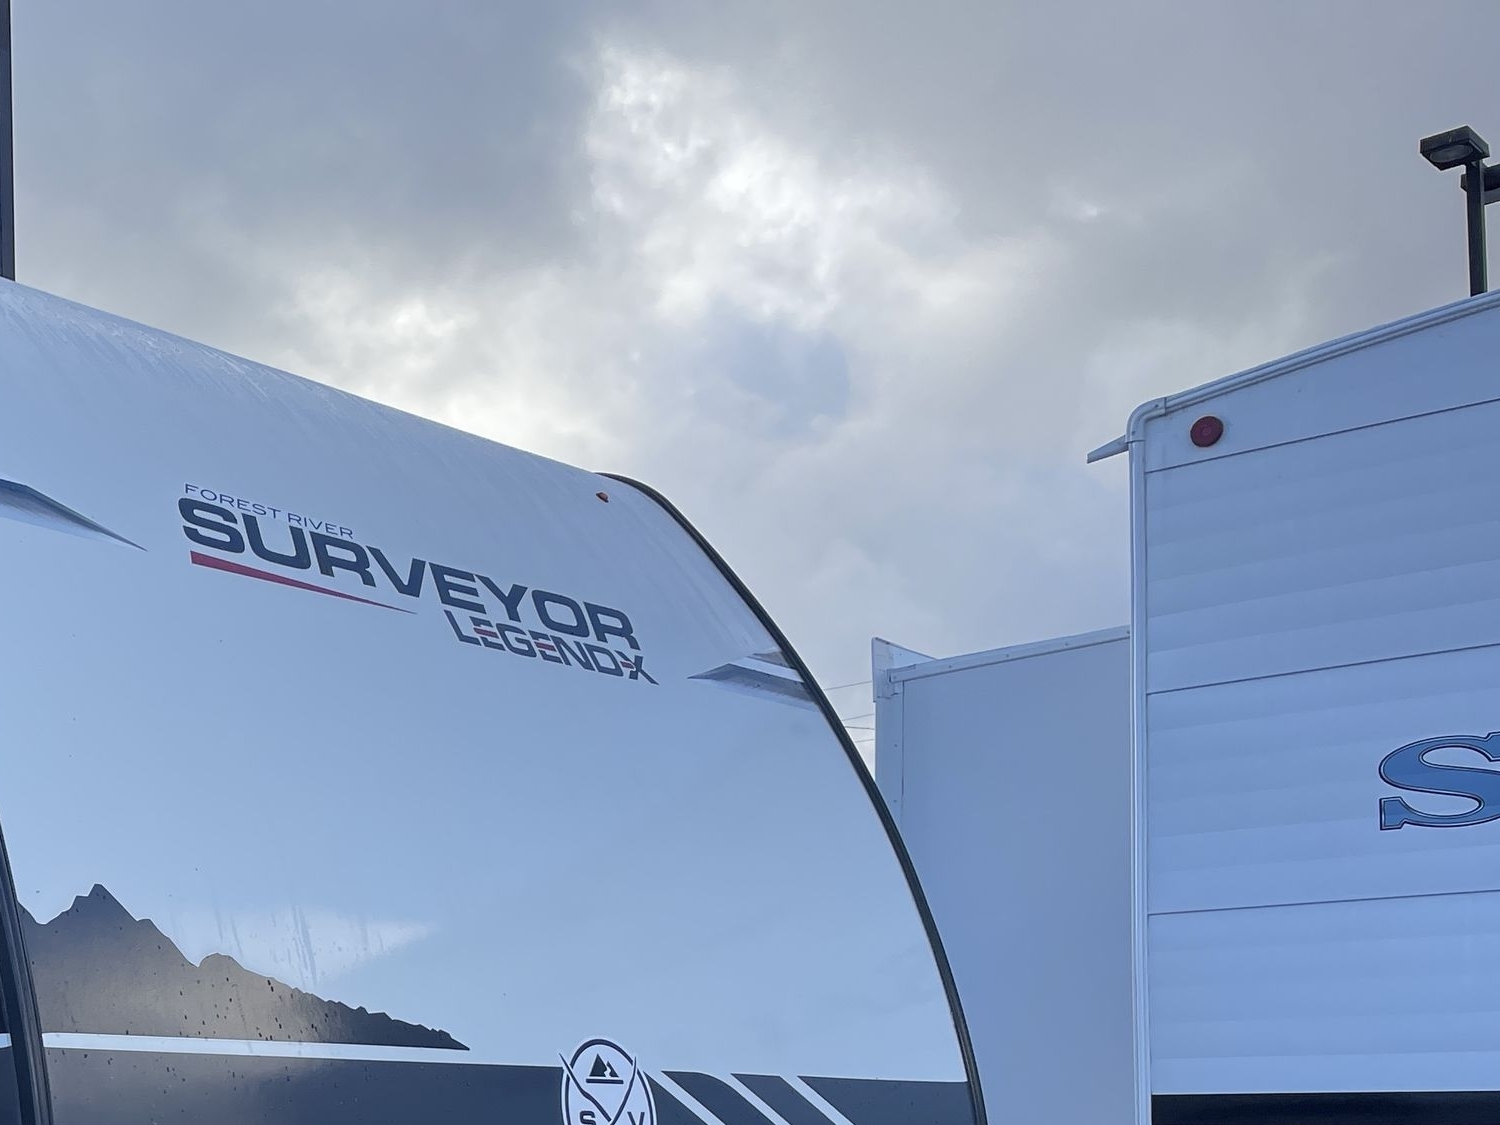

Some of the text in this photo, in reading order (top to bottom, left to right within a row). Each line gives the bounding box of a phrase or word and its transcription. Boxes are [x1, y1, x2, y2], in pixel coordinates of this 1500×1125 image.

[184, 483, 354, 540] FOREST RIVER
[178, 497, 641, 651] SURVEYOR
